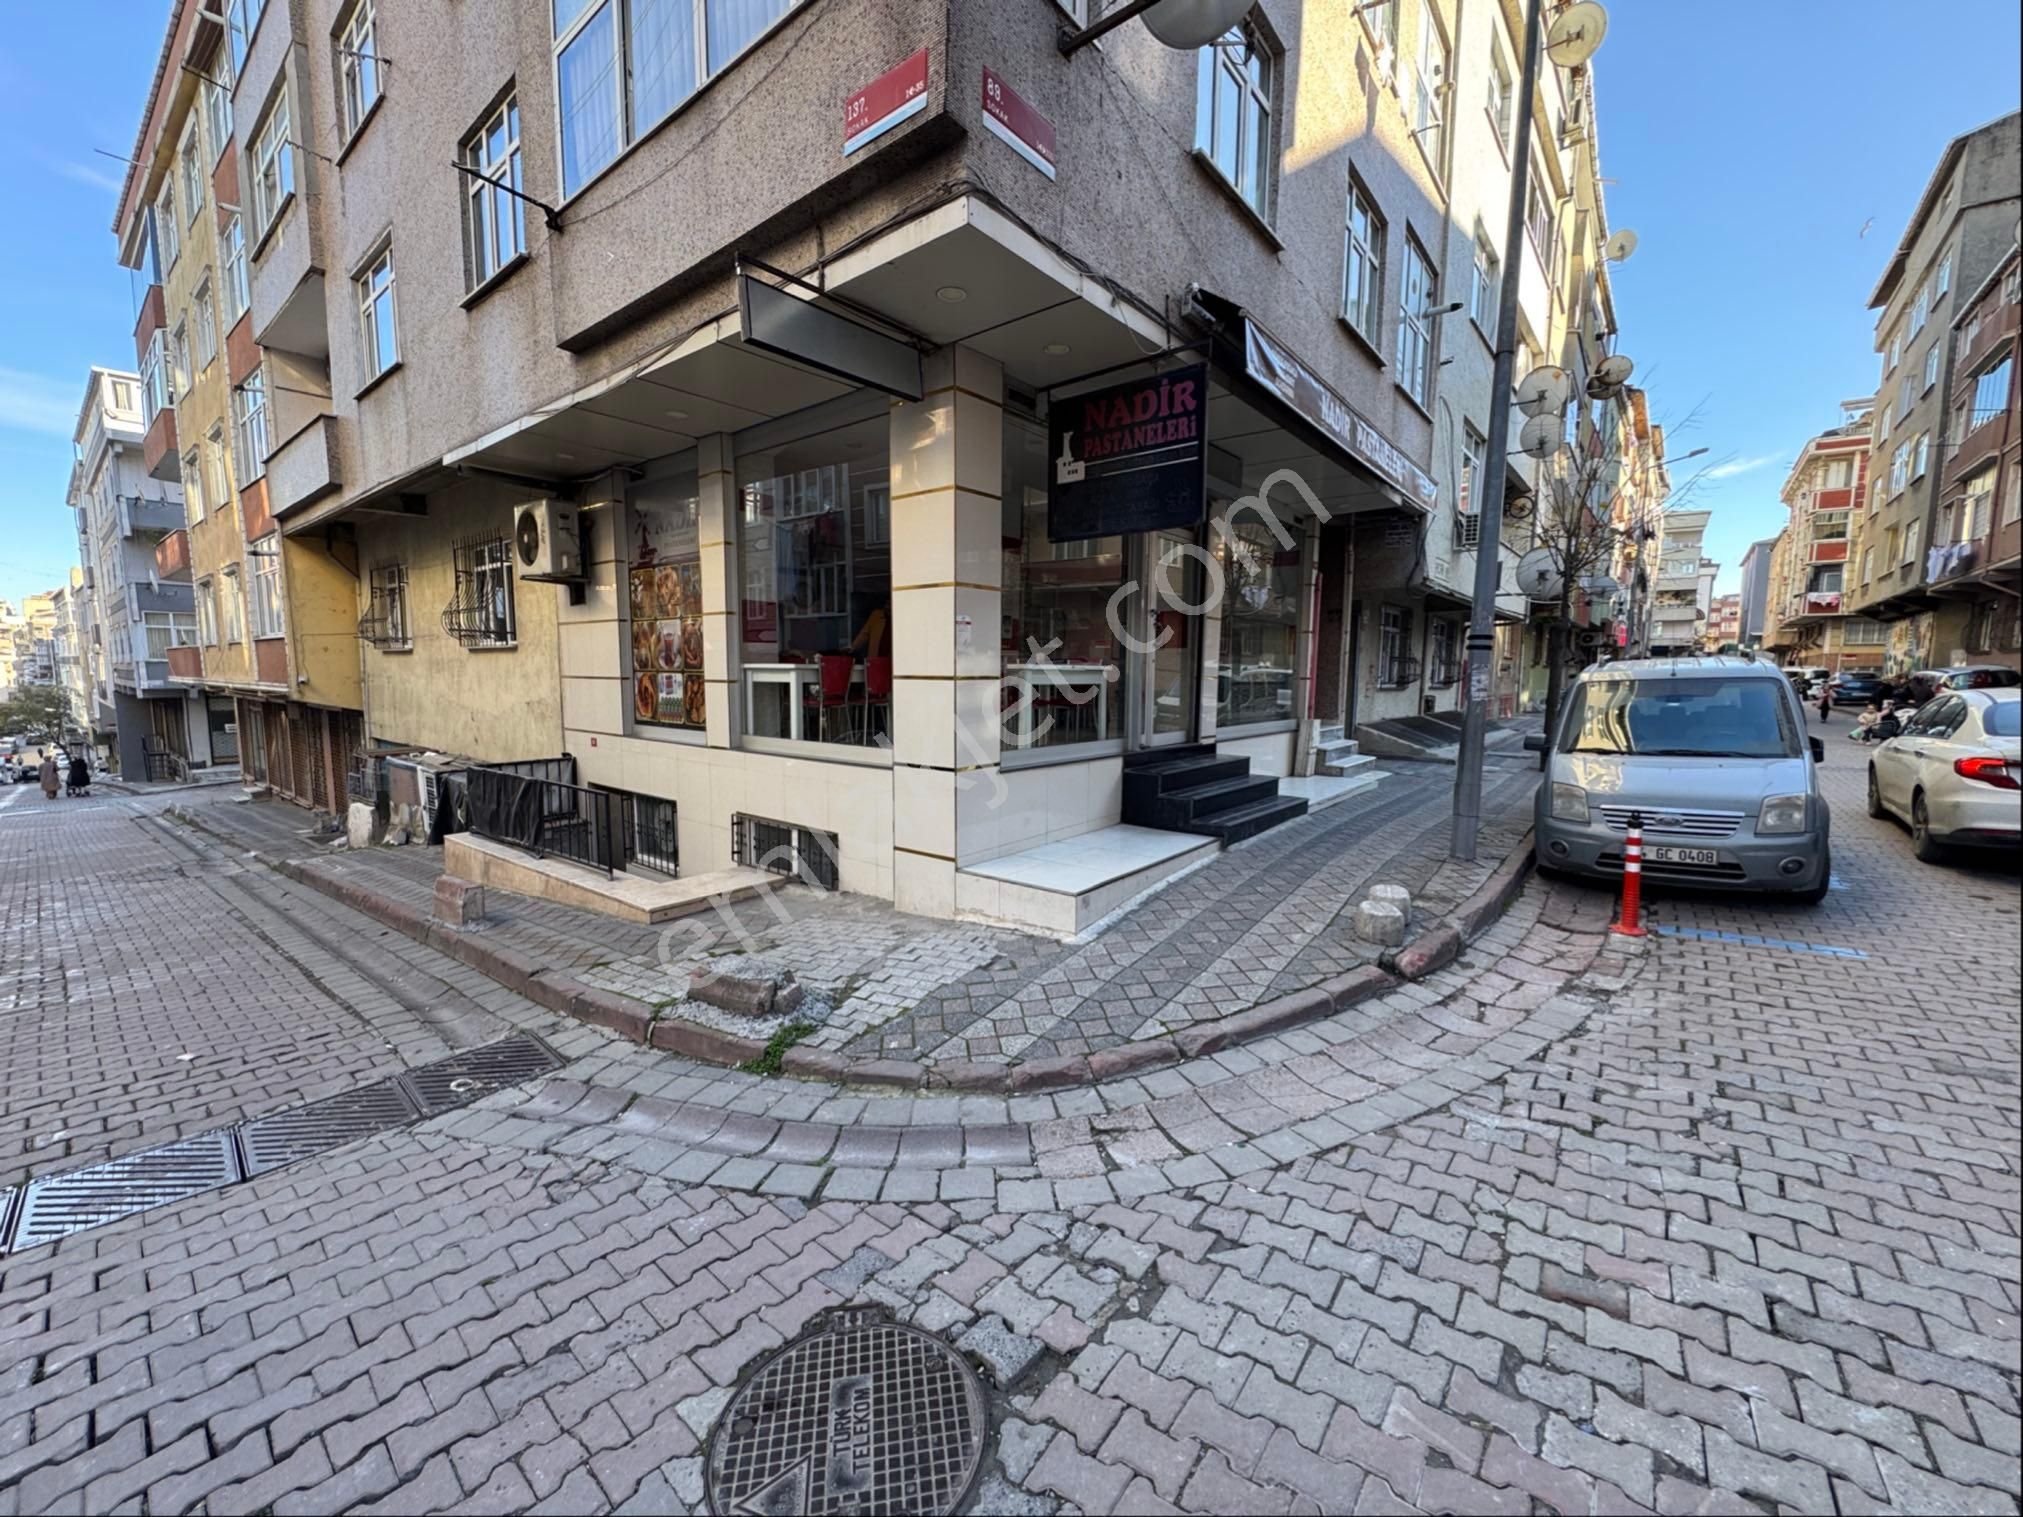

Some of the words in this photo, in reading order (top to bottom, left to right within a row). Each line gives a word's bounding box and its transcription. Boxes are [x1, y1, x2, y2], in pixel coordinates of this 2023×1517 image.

[1083, 378, 1197, 432] NADİR
[1656, 847, 1673, 860] GC
[1678, 850, 1714, 863] 0408
[830, 1408, 852, 1458] TÜRK
[852, 1387, 871, 1475] TELEKOM
